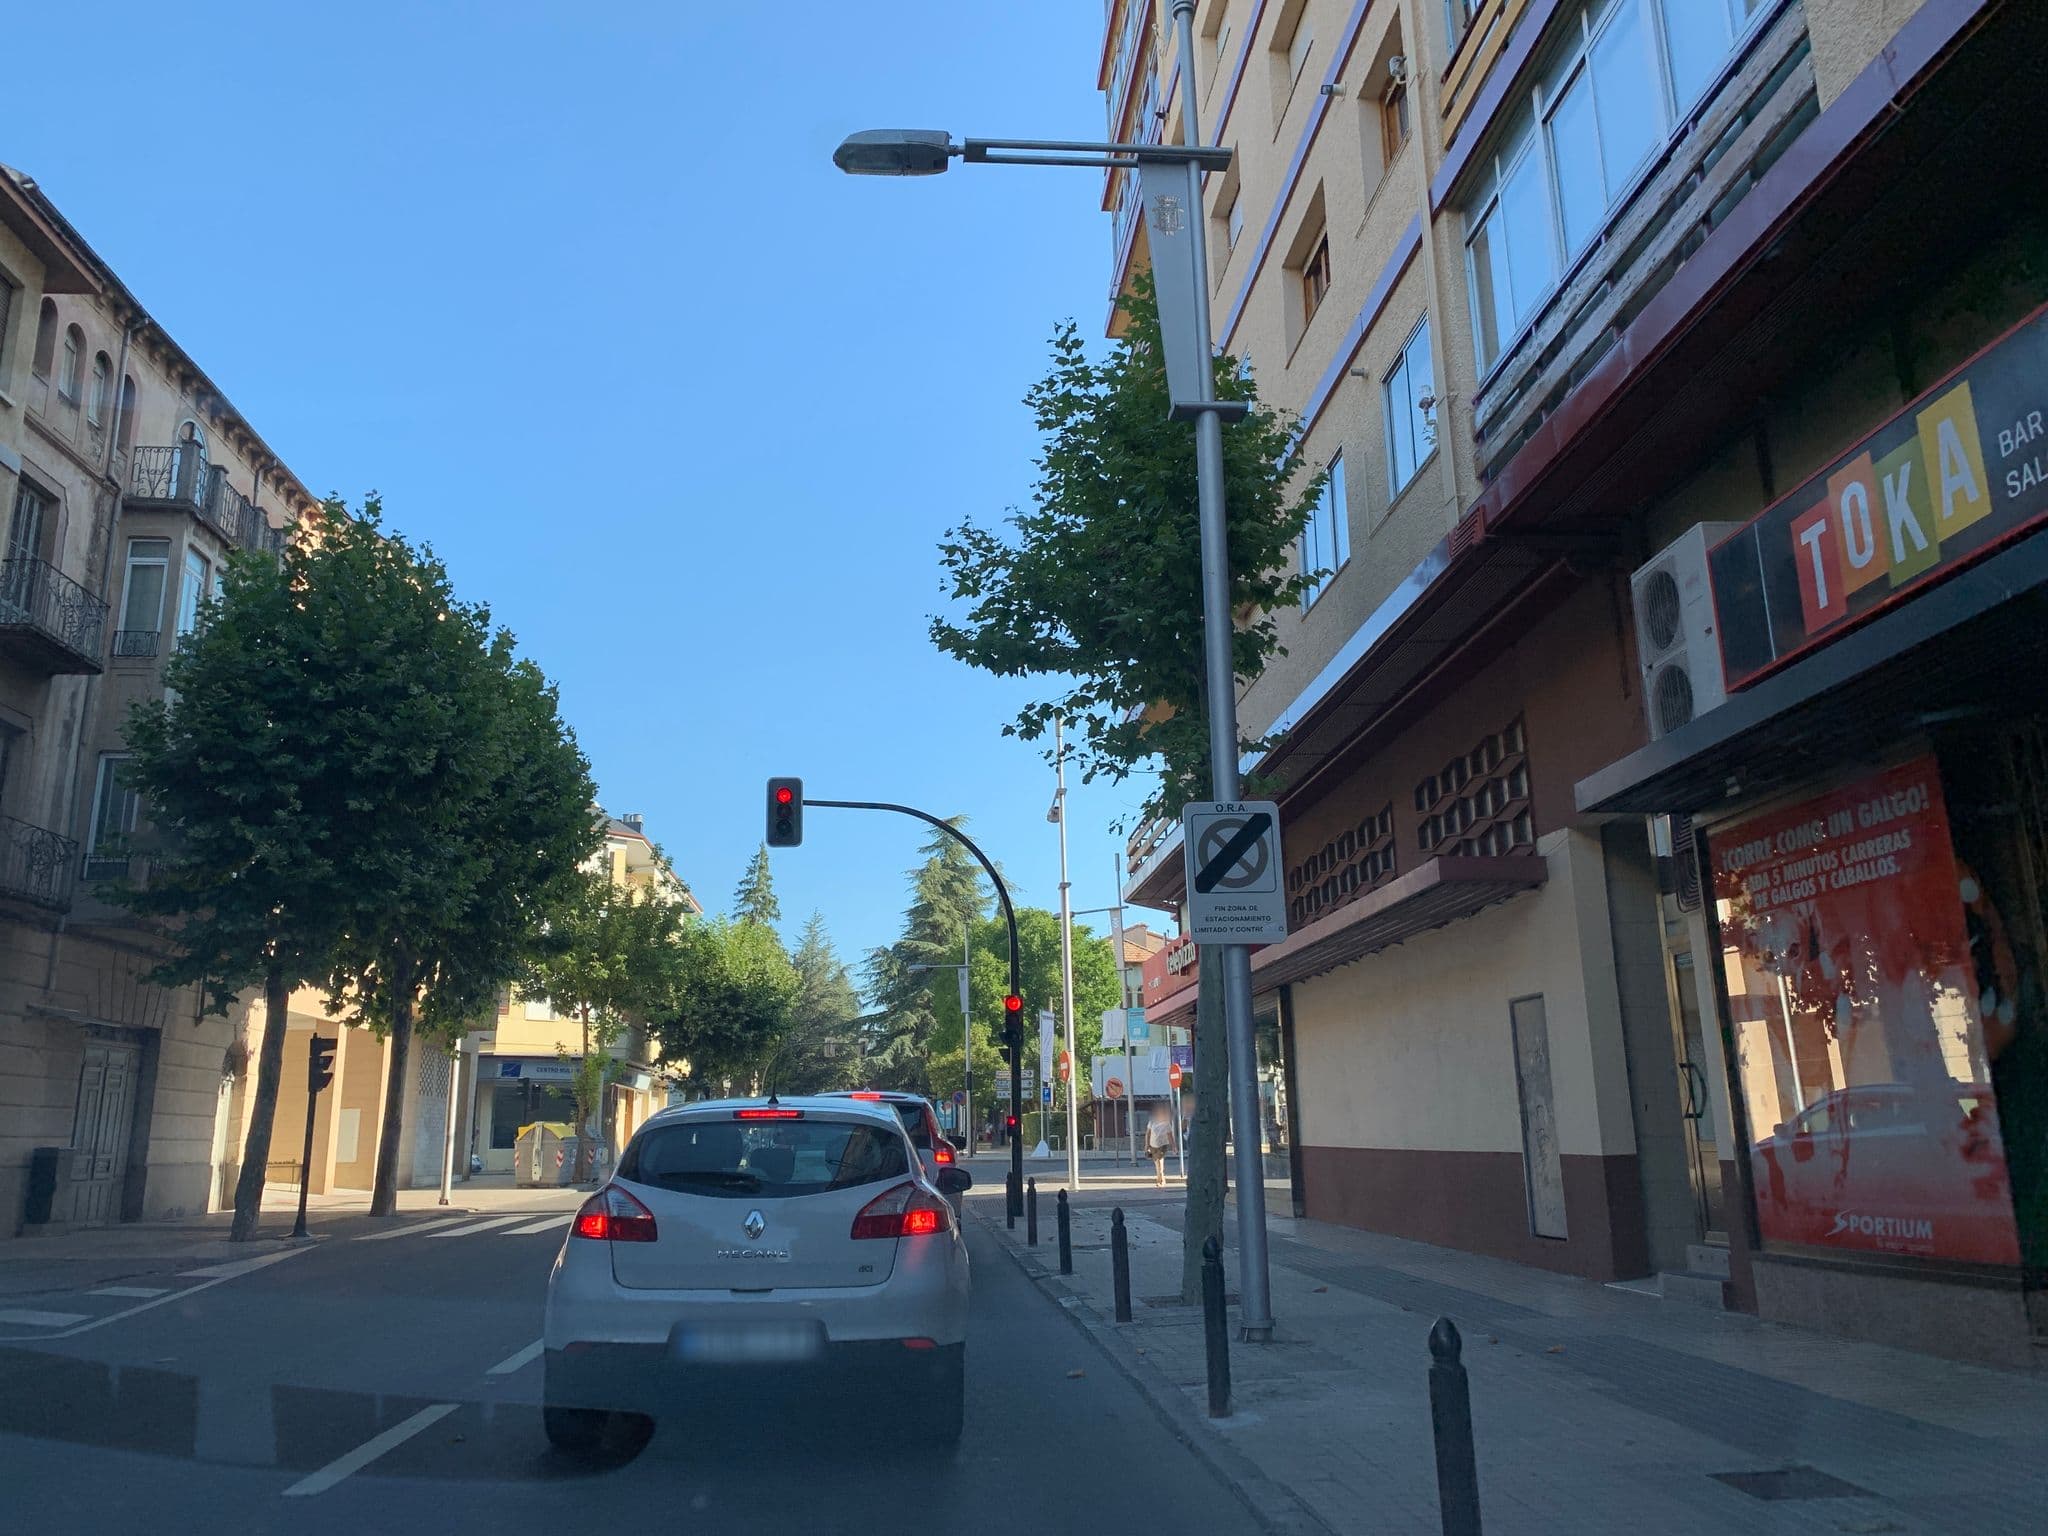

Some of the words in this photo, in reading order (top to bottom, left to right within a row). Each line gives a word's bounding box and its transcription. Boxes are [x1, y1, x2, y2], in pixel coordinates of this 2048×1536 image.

[1998, 410, 2044, 458] BAR
[2006, 456, 2048, 498] SAL
[1800, 417, 1980, 610] TOKA
[1777, 819, 1824, 853] COMO
[1828, 810, 1854, 837] UN
[1858, 784, 1930, 827] GALGO!
[1754, 891, 1769, 910] DE
[1771, 877, 1816, 903] GALGOS
[1818, 873, 1828, 892] Y
[1830, 855, 1900, 889] CABALLOS.
[1773, 867, 1781, 886] 5
[1783, 850, 1839, 882] MINUTOS
[1841, 829, 1911, 866] CARRERAS
[1824, 1208, 1933, 1240] SPORTIUM
